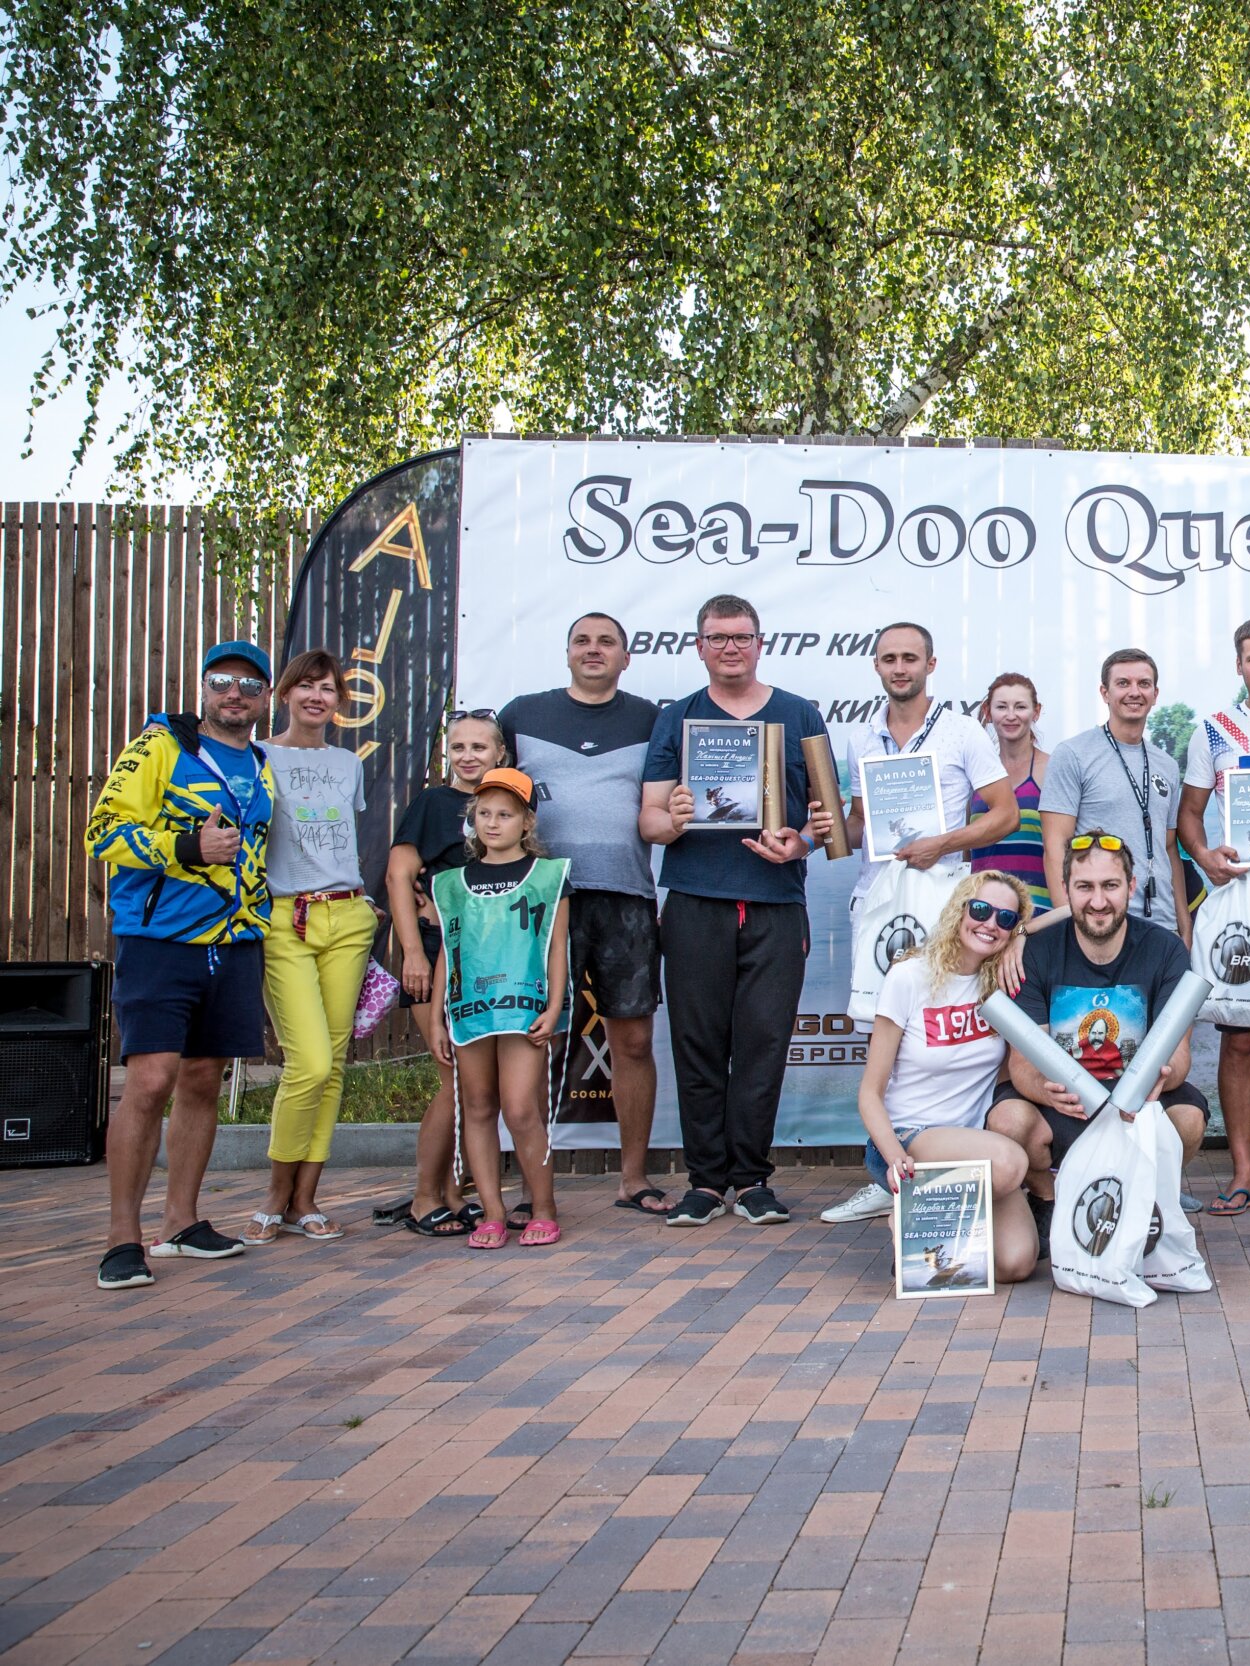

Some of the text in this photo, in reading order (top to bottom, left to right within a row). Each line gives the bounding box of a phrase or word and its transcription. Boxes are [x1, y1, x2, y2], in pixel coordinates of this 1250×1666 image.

[563, 474, 1036, 569] Sea-Doo
[629, 632, 698, 655] BRP
[757, 632, 820, 656] НТР
[699, 738, 751, 747] ДИПЛОМ
[875, 769, 926, 782] ДИПЛОМ
[470, 883, 494, 891] BORN
[789, 1047, 867, 1062] SPOR
[570, 1090, 614, 1099] COGNA
[912, 1184, 976, 1196] ДИПЛОМ
[904, 1231, 938, 1239] SEA-DOO
[940, 1230, 966, 1238] QUEST
